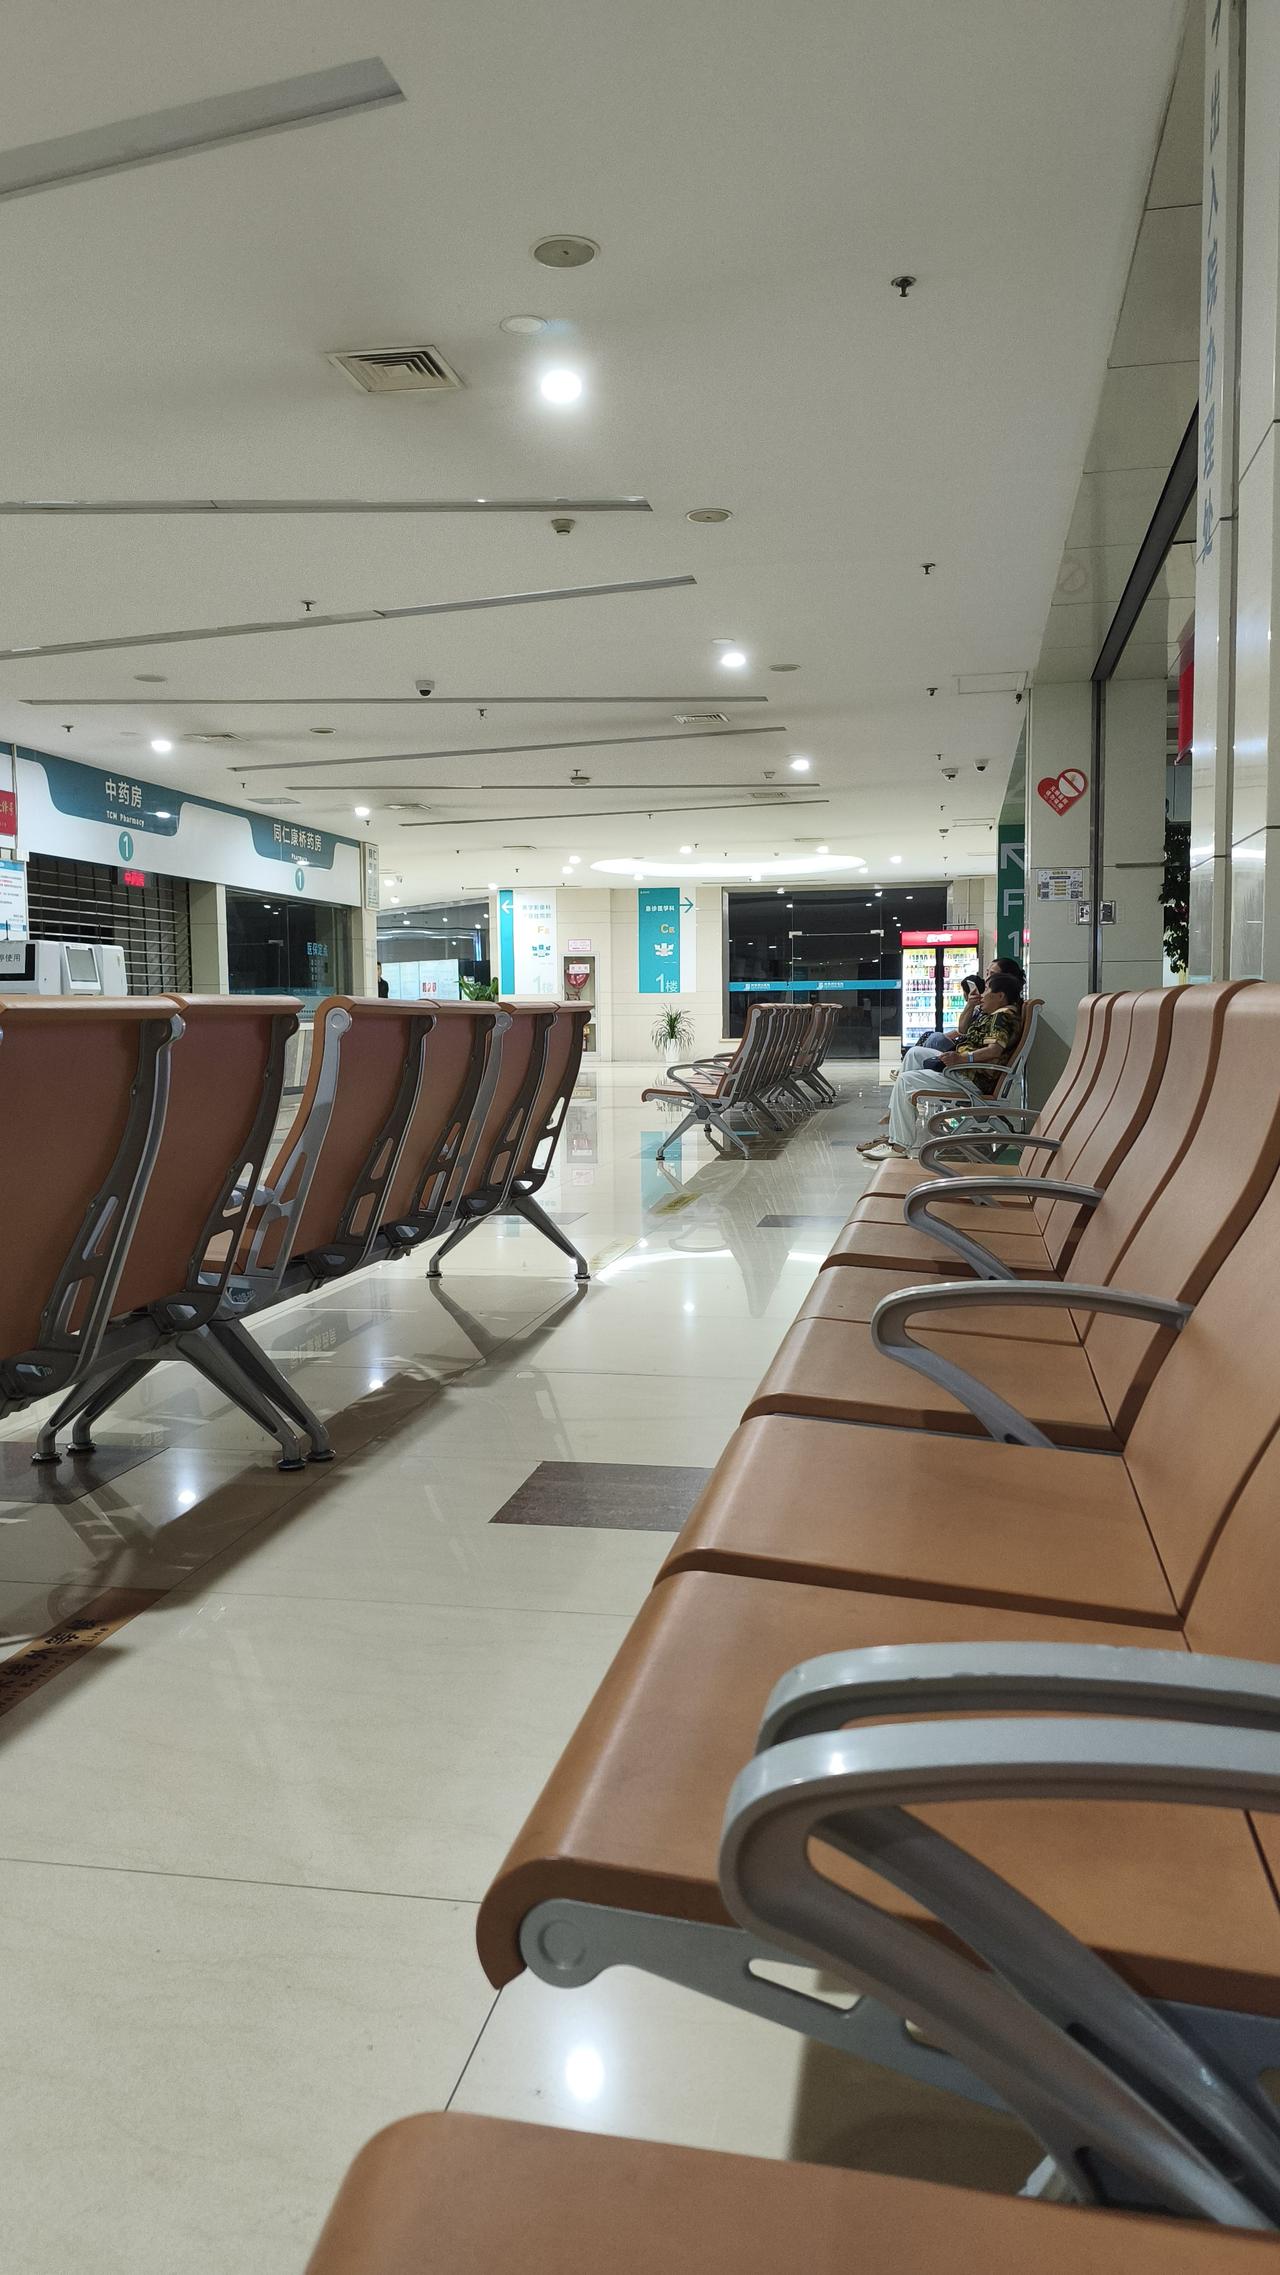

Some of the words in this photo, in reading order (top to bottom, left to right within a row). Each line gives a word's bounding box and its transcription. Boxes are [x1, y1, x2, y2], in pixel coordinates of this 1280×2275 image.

[105, 778, 143, 809] 中药房
[106, 810, 118, 821] TCM
[119, 813, 145, 828] Pharmacy
[122, 834, 129, 859] 1
[273, 823, 322, 852] 同仁康桥药房
[1003, 888, 1025, 917] F
[1007, 930, 1020, 957] 1
[655, 973, 678, 993] 1楼
[82, 1627, 110, 1642] Line
